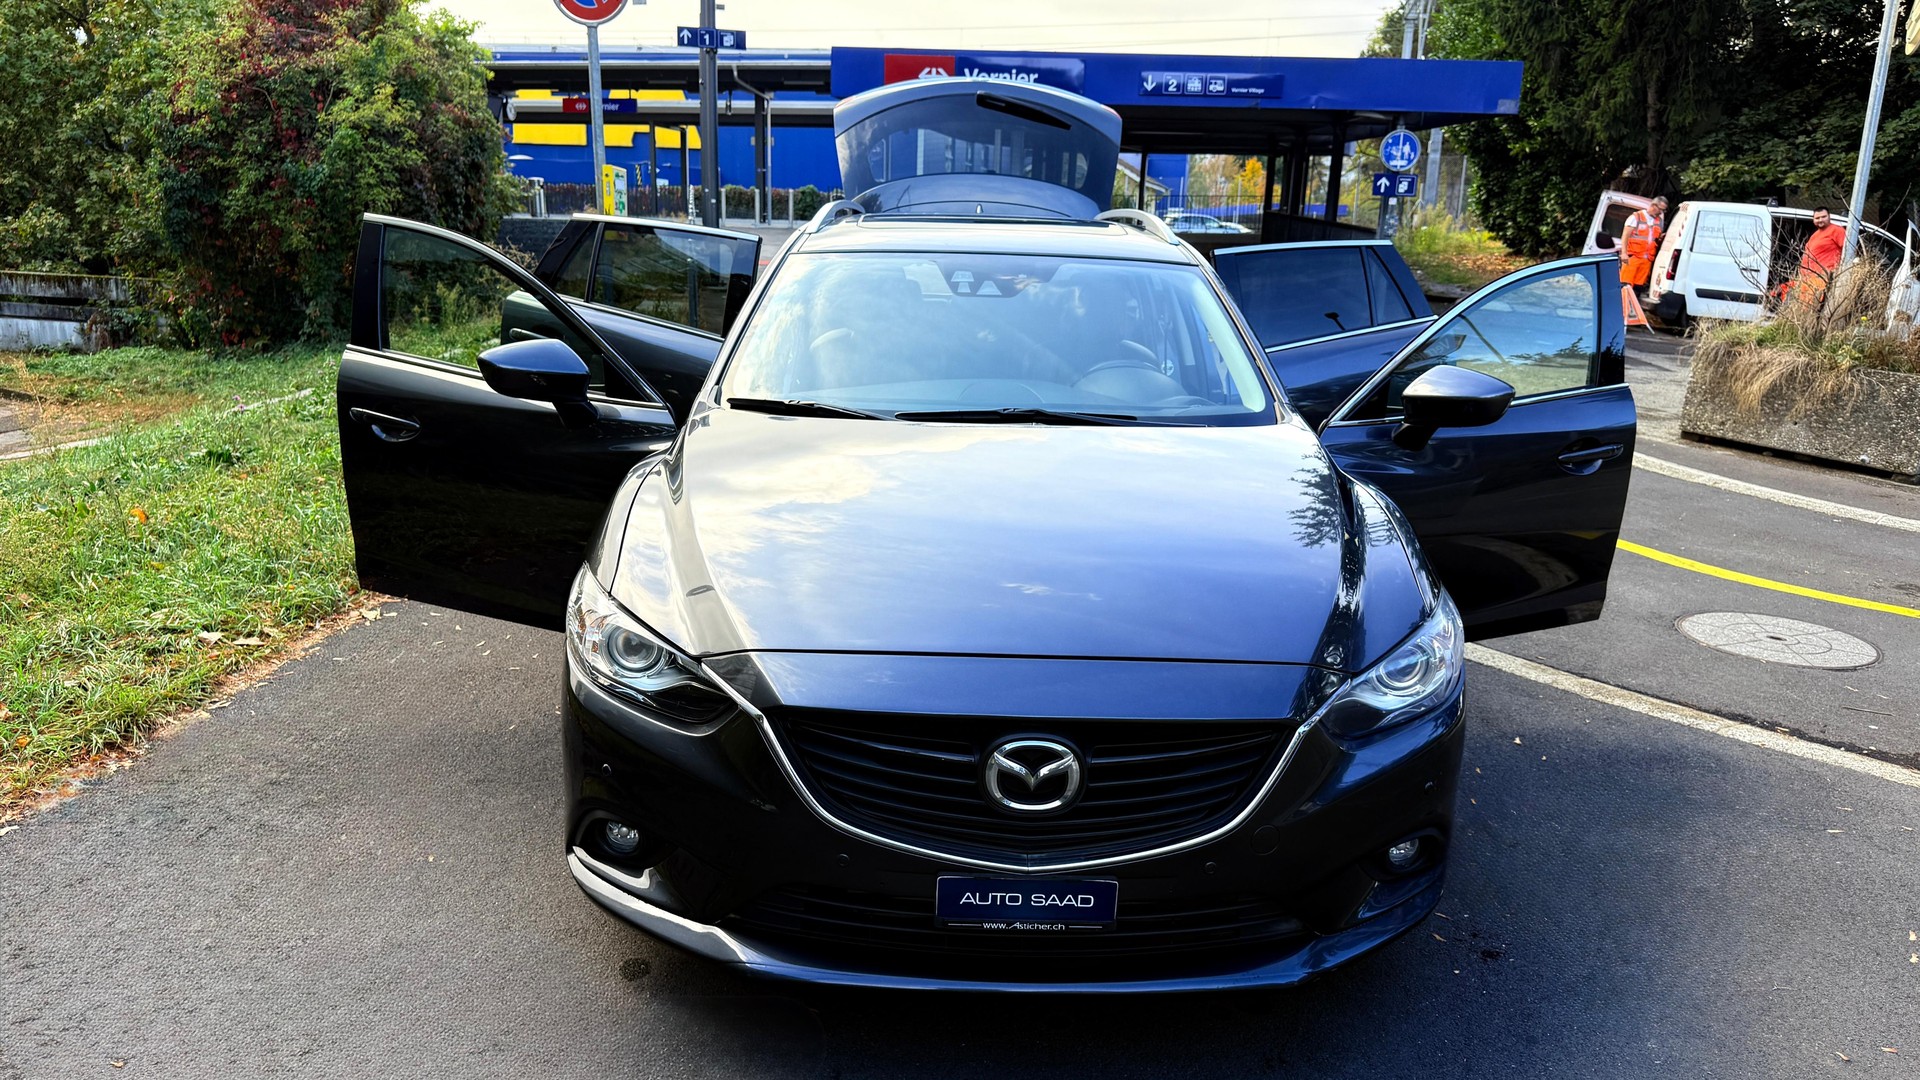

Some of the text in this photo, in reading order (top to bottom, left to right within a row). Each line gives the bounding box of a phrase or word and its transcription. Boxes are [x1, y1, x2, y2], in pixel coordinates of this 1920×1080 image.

[703, 34, 709, 46] 1
[1168, 79, 1177, 91] 2
[960, 892, 1094, 908] AUTO SAAD
[983, 921, 1065, 930] www.Asticher.ch
